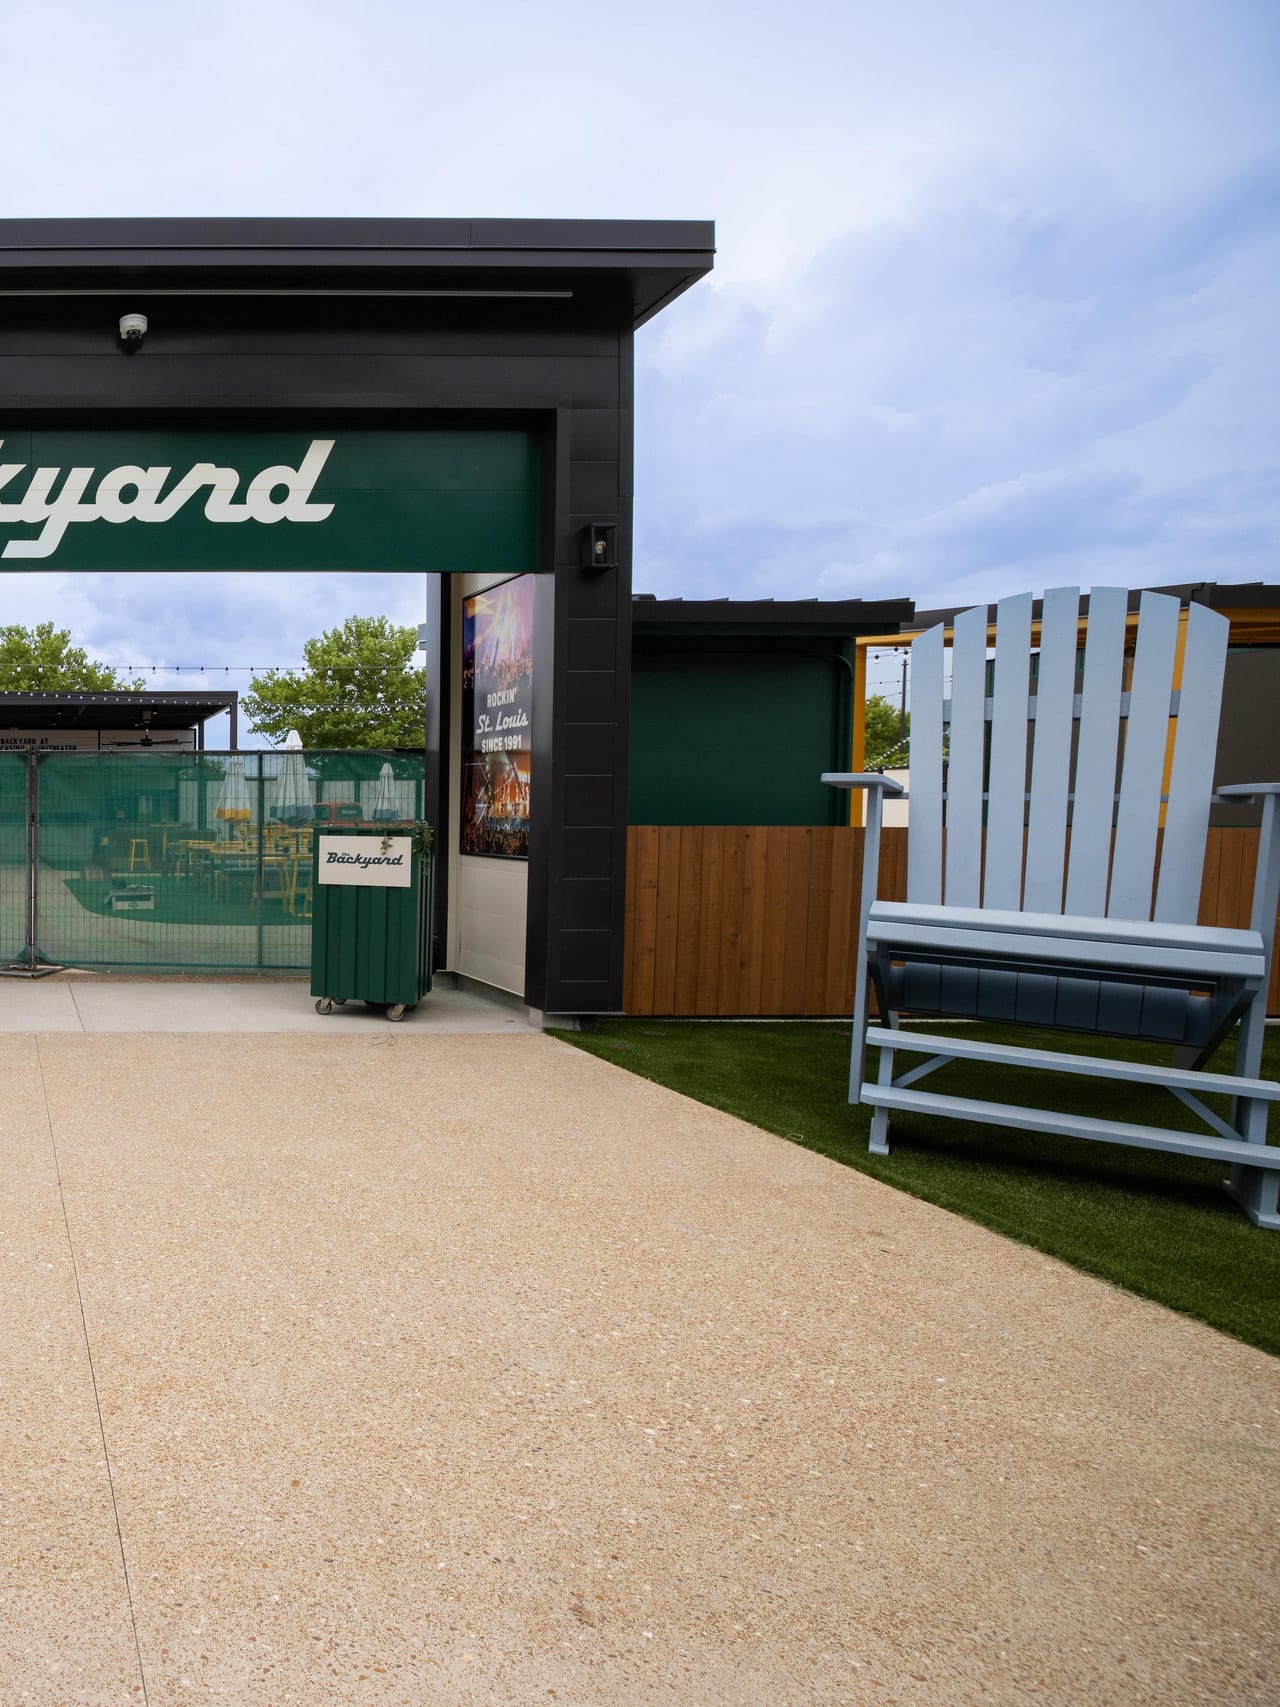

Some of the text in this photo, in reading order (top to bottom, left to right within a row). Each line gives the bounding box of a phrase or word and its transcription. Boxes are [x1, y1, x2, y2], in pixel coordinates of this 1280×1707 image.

[487, 687, 517, 708] ROCKIN'
[475, 708, 529, 735] St. Louis
[0, 737, 36, 745] BACKYARD
[40, 737, 49, 745] AT
[481, 733, 522, 754] SINCE 1991
[326, 852, 404, 869] Backyard
